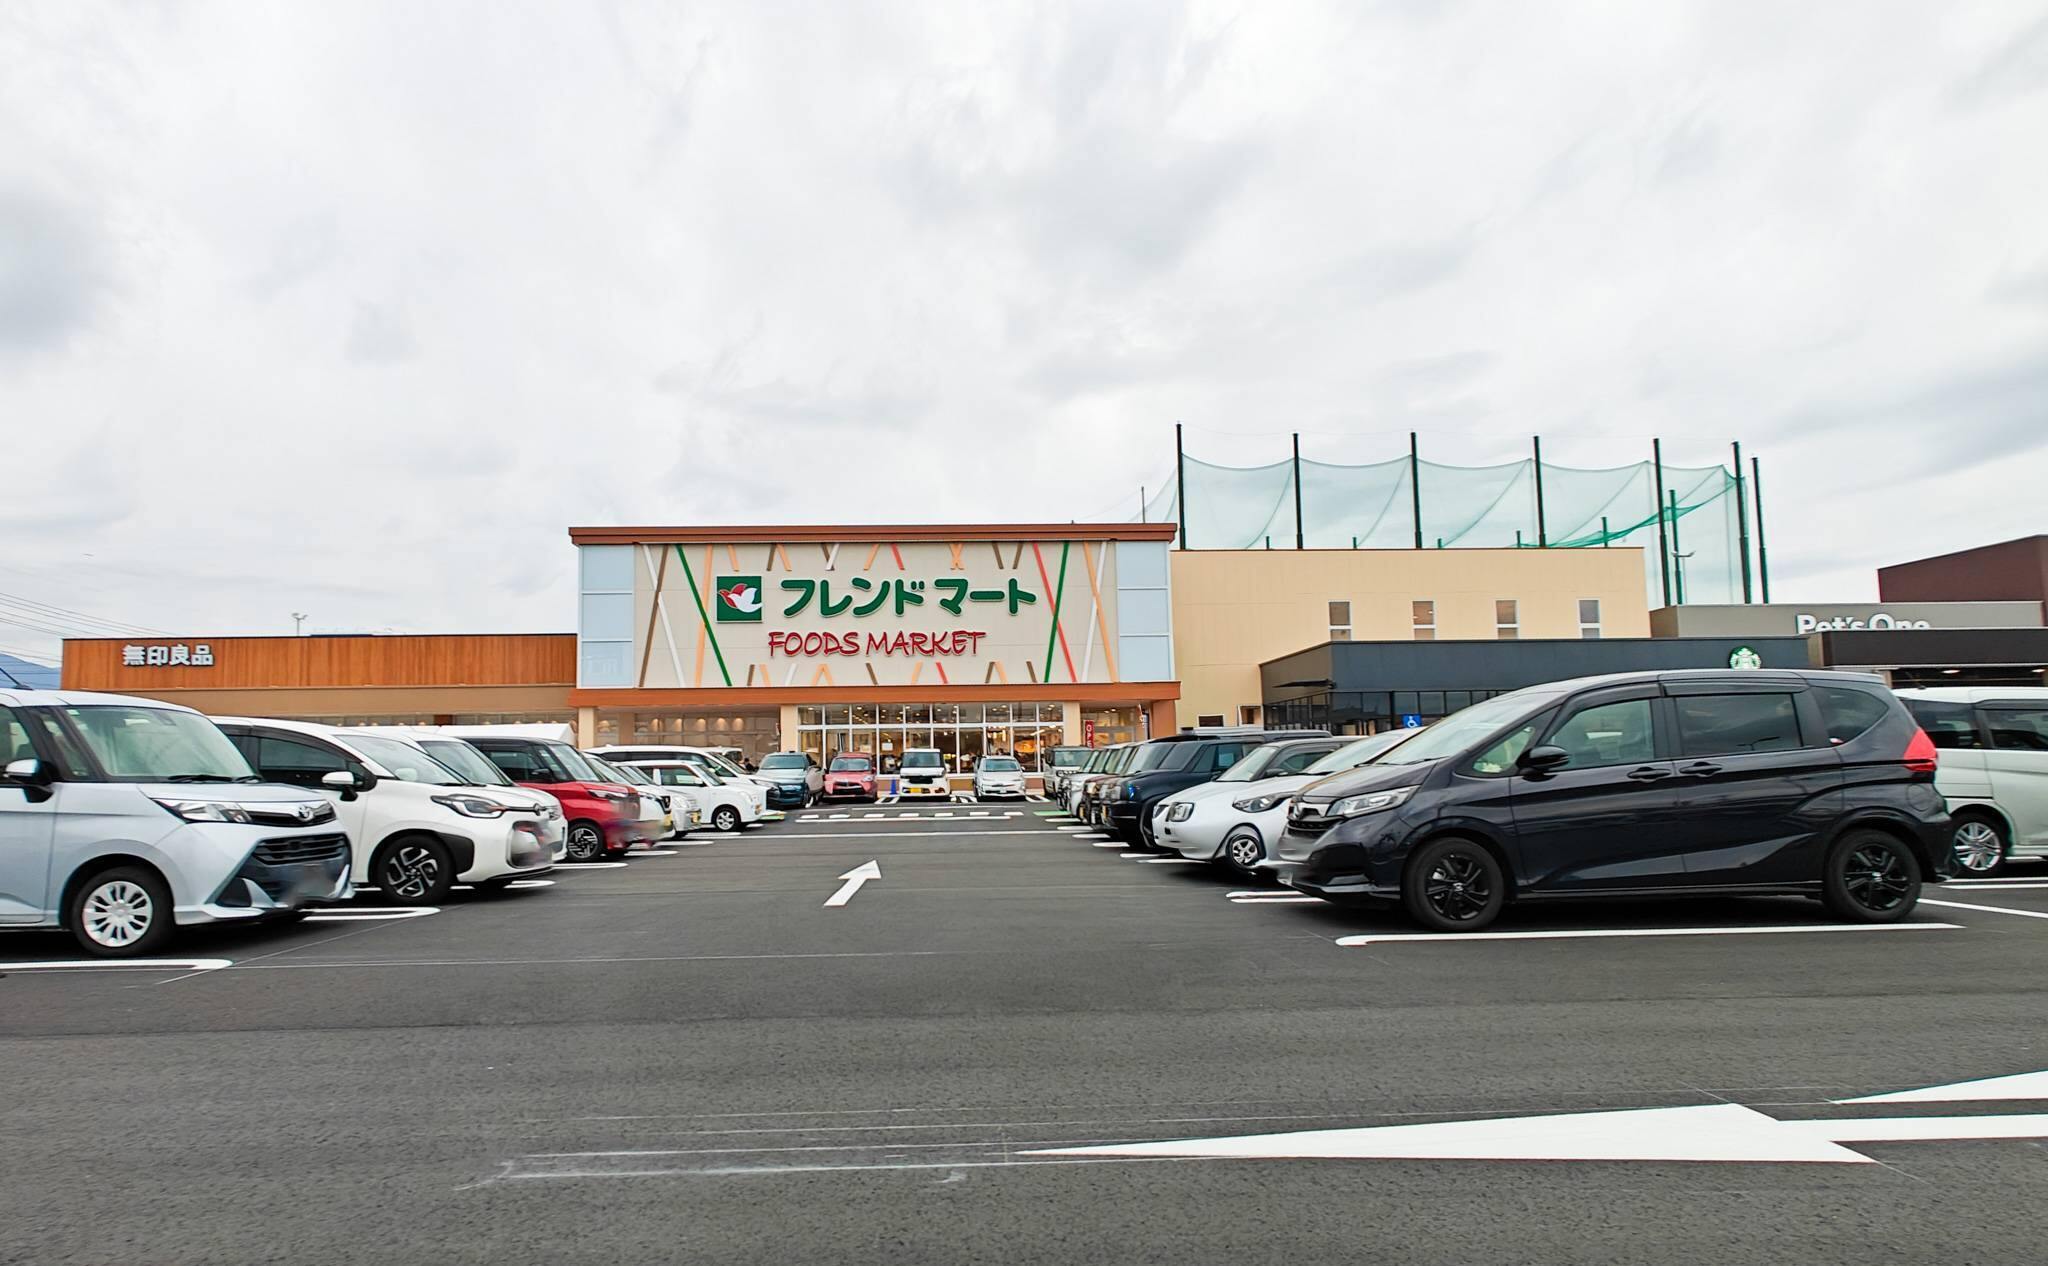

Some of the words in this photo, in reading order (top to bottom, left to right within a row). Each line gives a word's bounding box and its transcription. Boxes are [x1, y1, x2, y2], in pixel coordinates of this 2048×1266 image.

[122, 643, 214, 667] 無印良品
[768, 631, 860, 656] FOODS
[865, 630, 986, 656] MARKET
